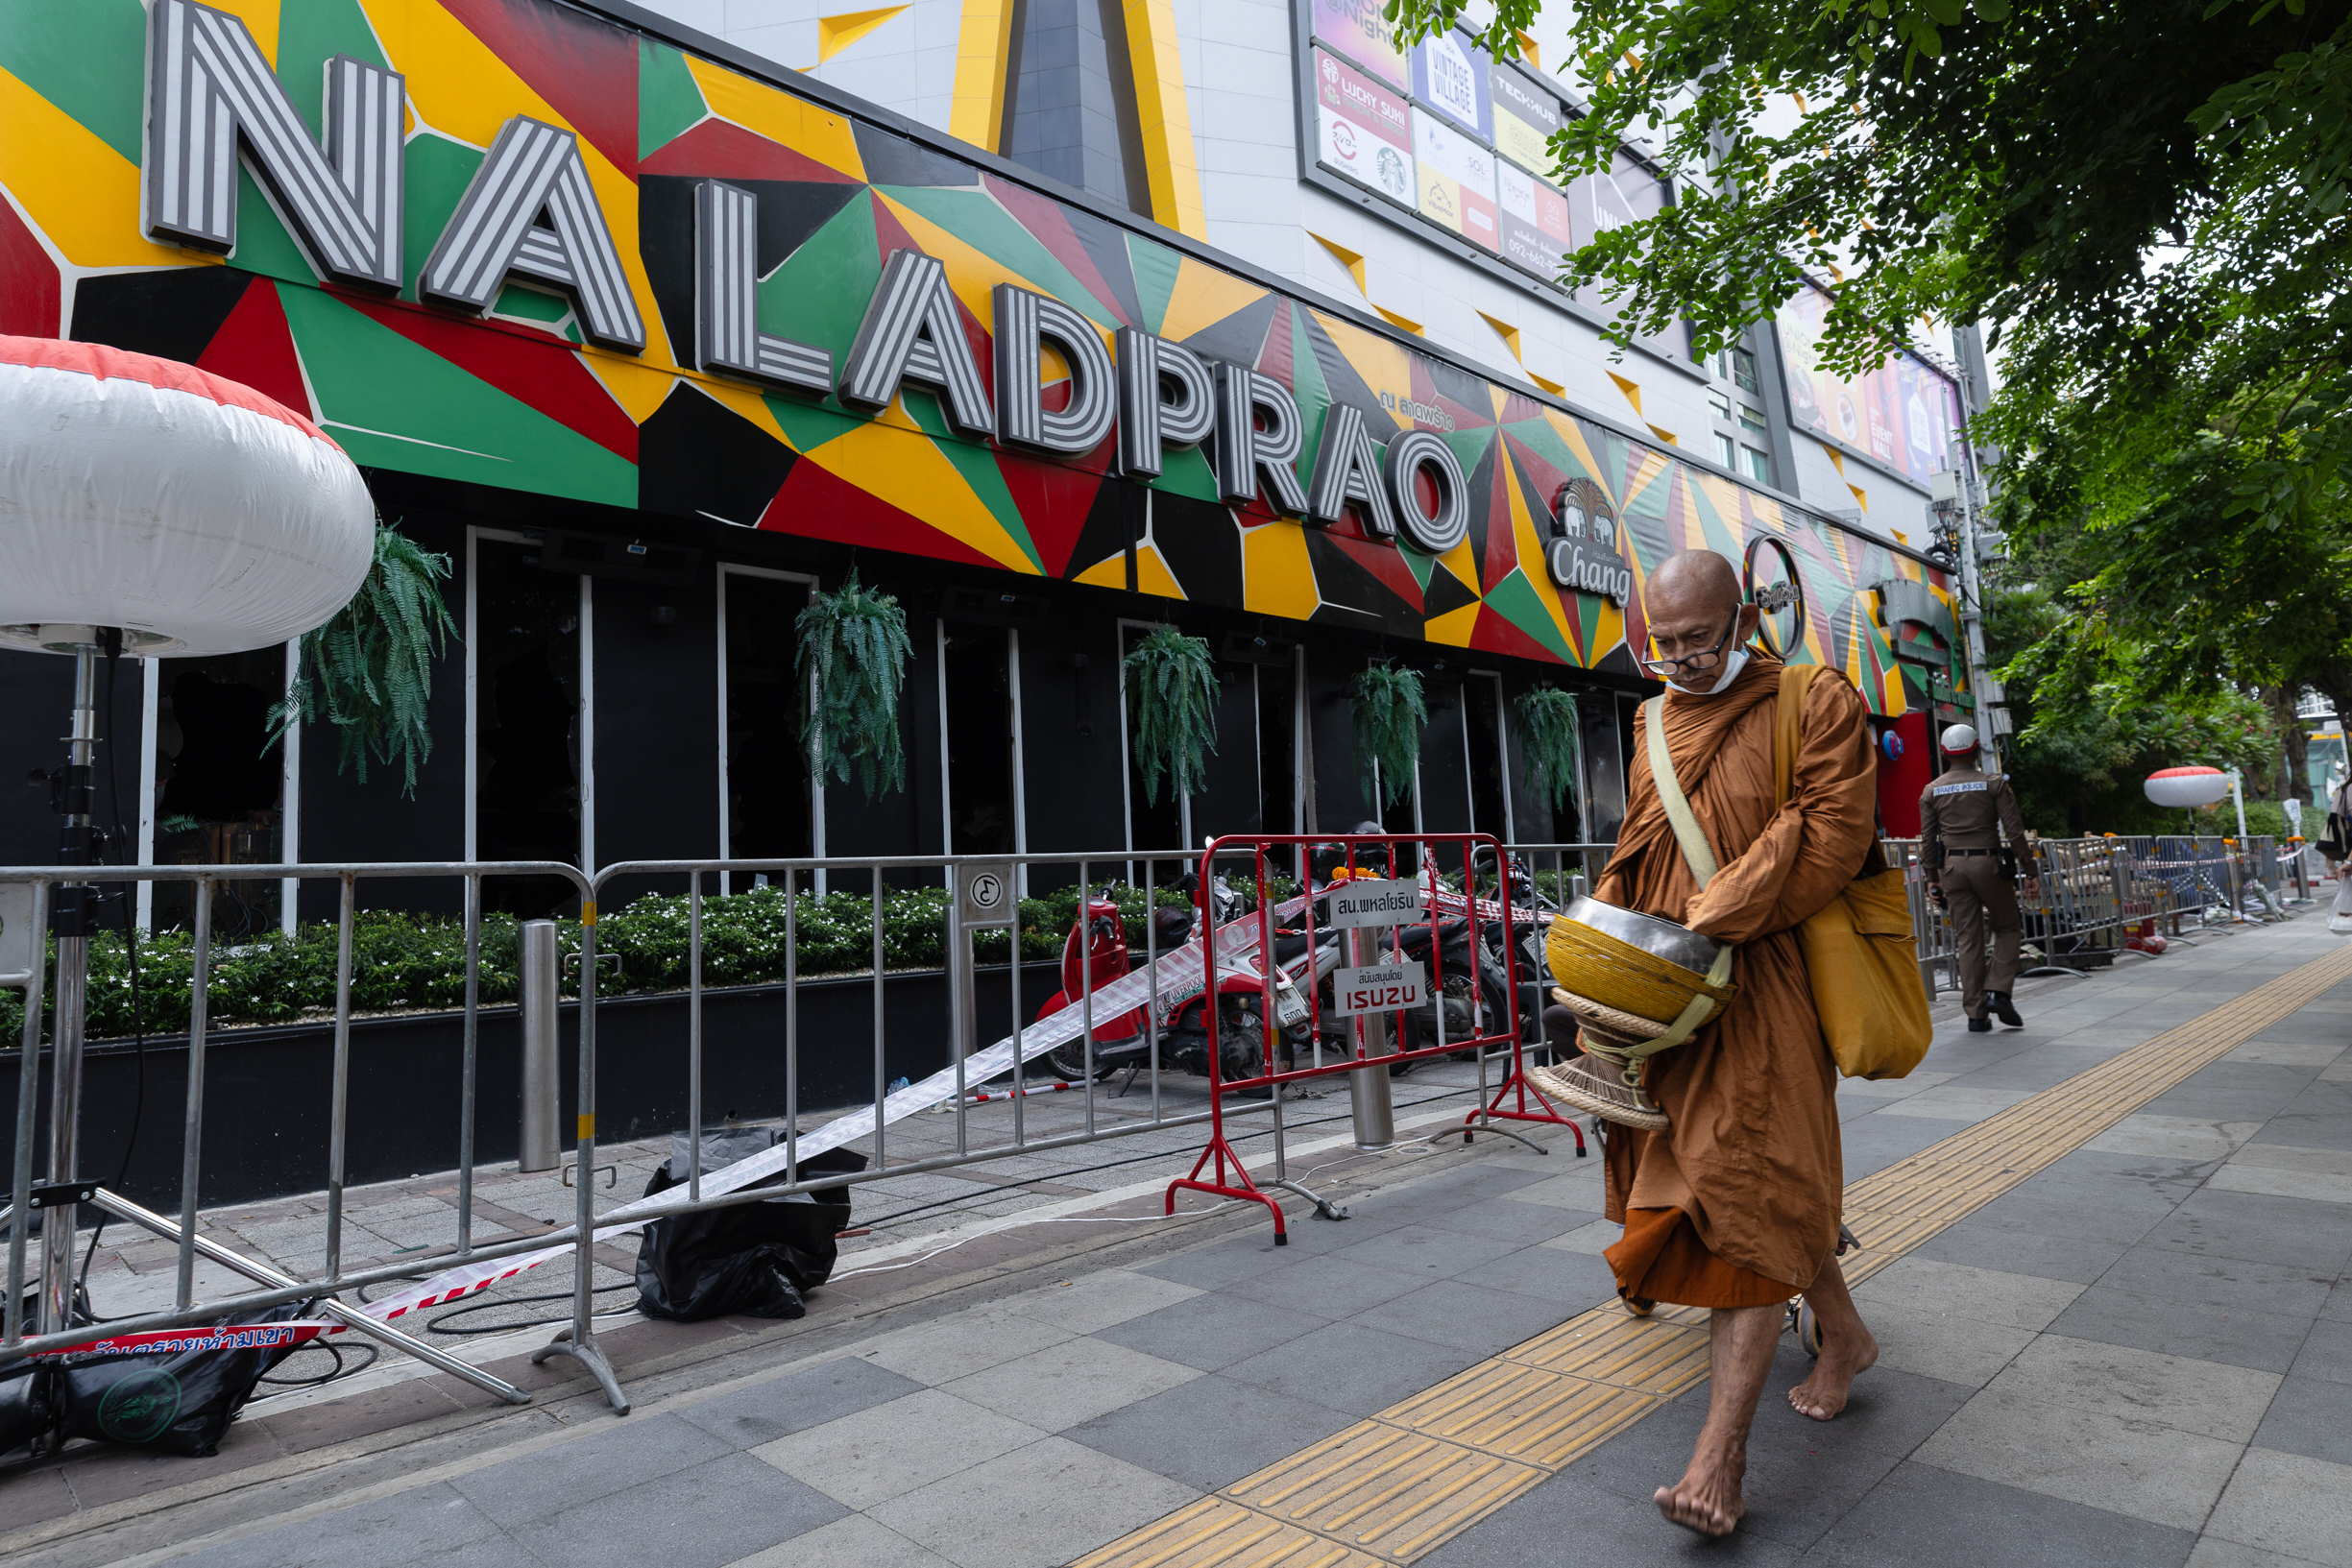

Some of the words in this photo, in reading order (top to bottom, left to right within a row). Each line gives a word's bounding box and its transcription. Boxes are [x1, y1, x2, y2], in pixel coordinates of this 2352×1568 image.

[1432, 47, 1469, 91] VINTAGE
[1342, 77, 1377, 109] LUCKY
[1380, 101, 1405, 126] SUKI
[1434, 71, 1471, 114] VILLAGE
[1373, 114, 1379, 123] &
[1333, 157, 1359, 176] SUSHIRO
[1467, 157, 1486, 176] SOL
[698, 178, 1470, 555] LADPRAO
[1379, 389, 1396, 412] ณ
[1398, 397, 1455, 433] ลาดพร้าว
[1871, 422, 1893, 446] EVENT
[1873, 437, 1892, 460] MALL
[1552, 539, 1631, 608] Chang
[1936, 784, 1960, 794] TRAFFIC
[1962, 782, 1983, 790] POLICE
[1338, 892, 1414, 914] สน.พหลโยธิน
[1170, 974, 1204, 1000] LIVERPOOL
[1358, 970, 1402, 985] สนับสนุนโดย
[1346, 984, 1416, 1010] ISUZU
[1283, 1008, 1303, 1022] 600
